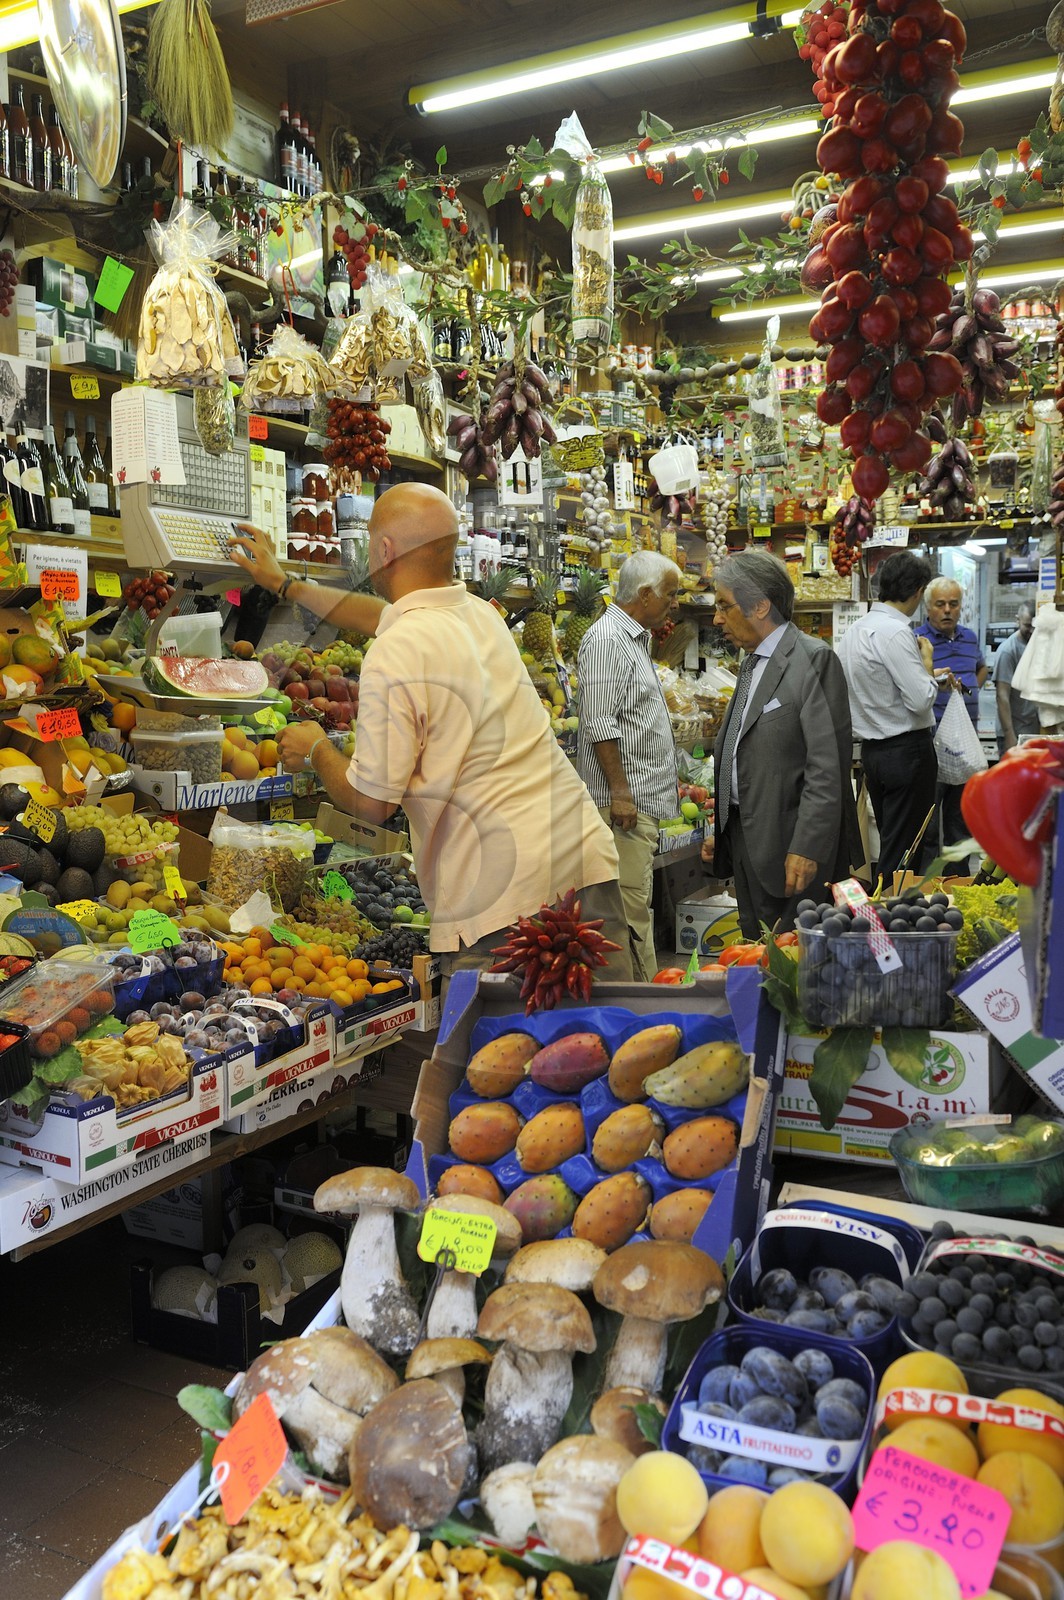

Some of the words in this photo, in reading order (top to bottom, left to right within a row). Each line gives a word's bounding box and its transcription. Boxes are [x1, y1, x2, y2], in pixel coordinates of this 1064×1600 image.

[43, 556, 59, 564] igiene,
[41, 722, 47, 734] €
[179, 783, 256, 810] Marlene
[984, 988, 1004, 1004] ITALIA
[382, 1011, 411, 1031] VIGNOLA
[283, 1057, 315, 1081] VIGNOLA
[83, 1105, 105, 1117] VIGNOLA
[157, 1115, 200, 1141] VIGNOLA
[28, 1148, 58, 1163] VIGNOLA
[60, 1167, 130, 1211] WASHINGTON
[131, 1153, 160, 1179] STATE
[162, 1133, 207, 1164] CHERRIES
[834, 1220, 882, 1240] ASTA
[692, 1420, 742, 1447] ASTA
[743, 1436, 814, 1461] FRUTTALTEDO
[865, 1490, 888, 1518] €
